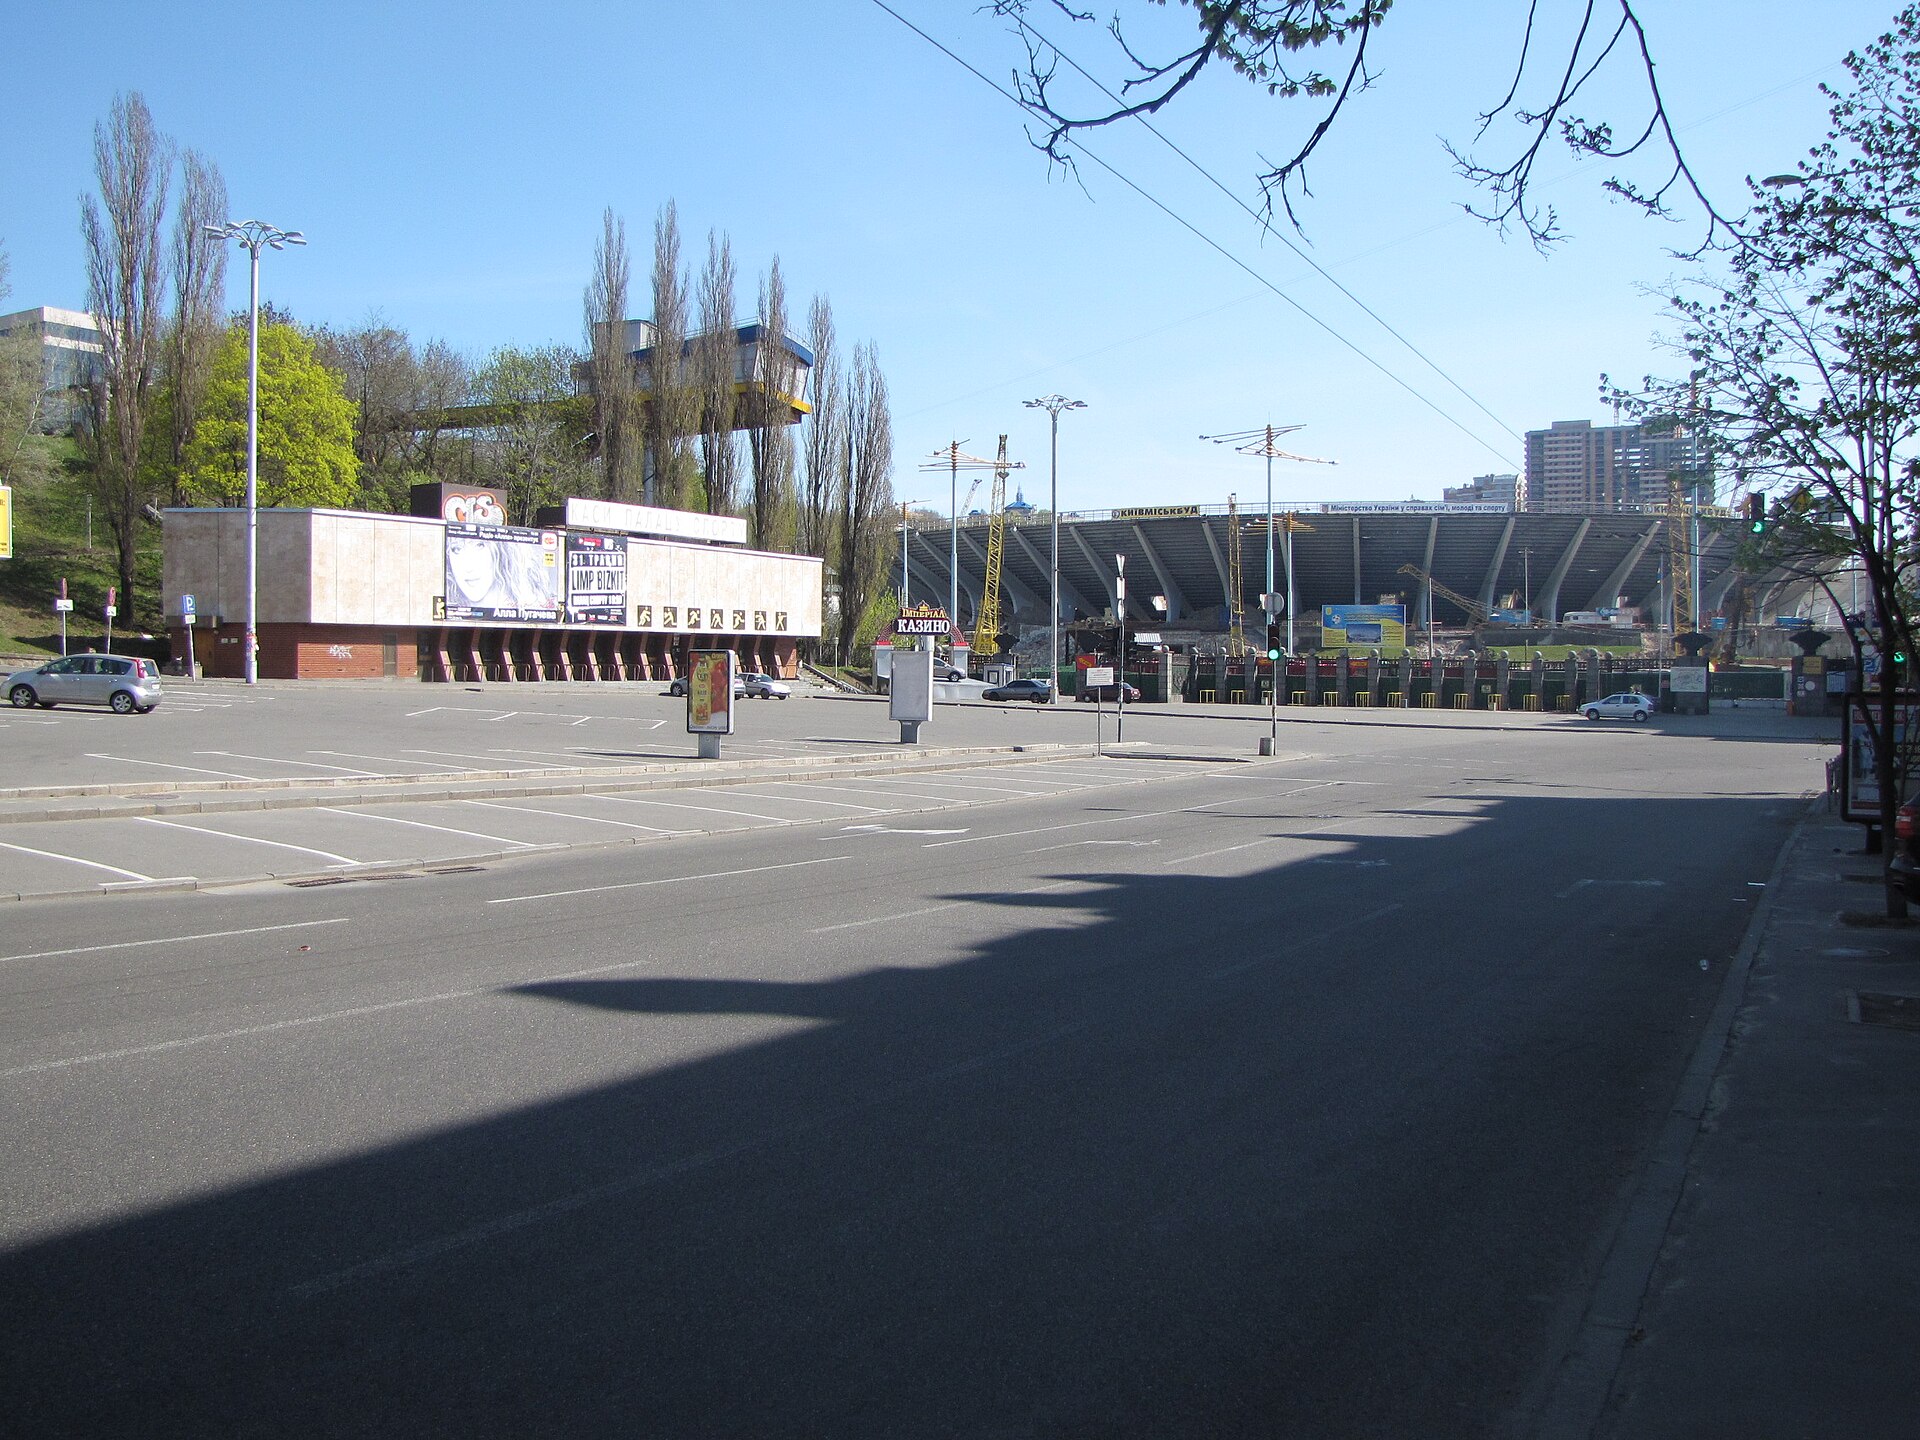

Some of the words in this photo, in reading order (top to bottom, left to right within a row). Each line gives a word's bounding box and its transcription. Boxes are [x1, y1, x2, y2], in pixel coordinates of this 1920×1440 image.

[1120, 506, 1199, 517] КИЇВМІСЬКБУД
[1374, 504, 1400, 512] України
[1451, 504, 1474, 512] молоді
[571, 502, 611, 522] КАСИ
[624, 508, 680, 531] ПАЛАЦУ
[693, 516, 746, 538] СПОРТУ
[571, 570, 595, 591] LIMP
[597, 570, 625, 591] BIZKIT
[186, 597, 194, 612] P
[493, 608, 517, 618] Алла
[518, 608, 557, 621] Пугачева
[902, 608, 945, 618] ІМПЕРІАЛ
[897, 618, 951, 634] КАЗИНО
